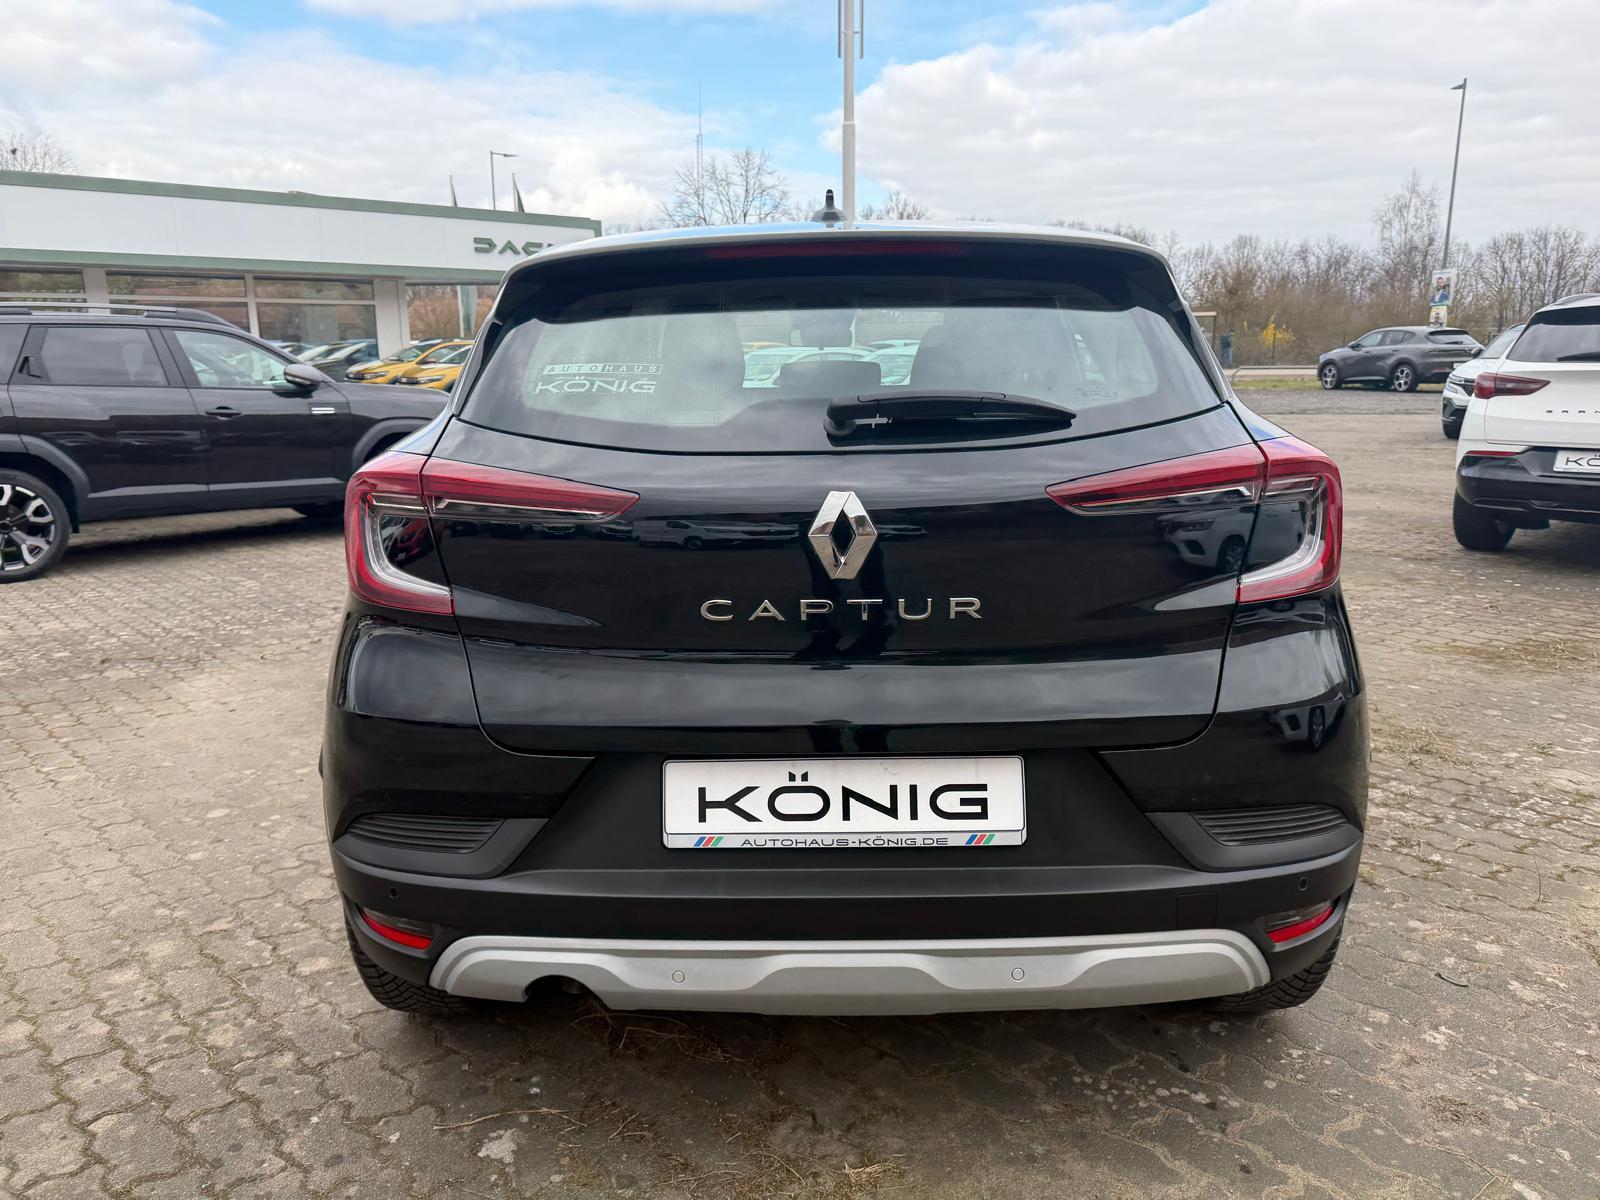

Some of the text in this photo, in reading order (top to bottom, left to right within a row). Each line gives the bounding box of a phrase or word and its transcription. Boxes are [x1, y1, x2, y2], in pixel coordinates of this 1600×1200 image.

[473, 237, 553, 255] DAC
[548, 364, 657, 373] AUTOHAUS
[535, 376, 657, 393] KÖNIG
[700, 597, 983, 621] CAPTUR
[697, 770, 989, 823] KÖNIG
[741, 835, 949, 848] AUTOHAUS-KÖNIG.DE
